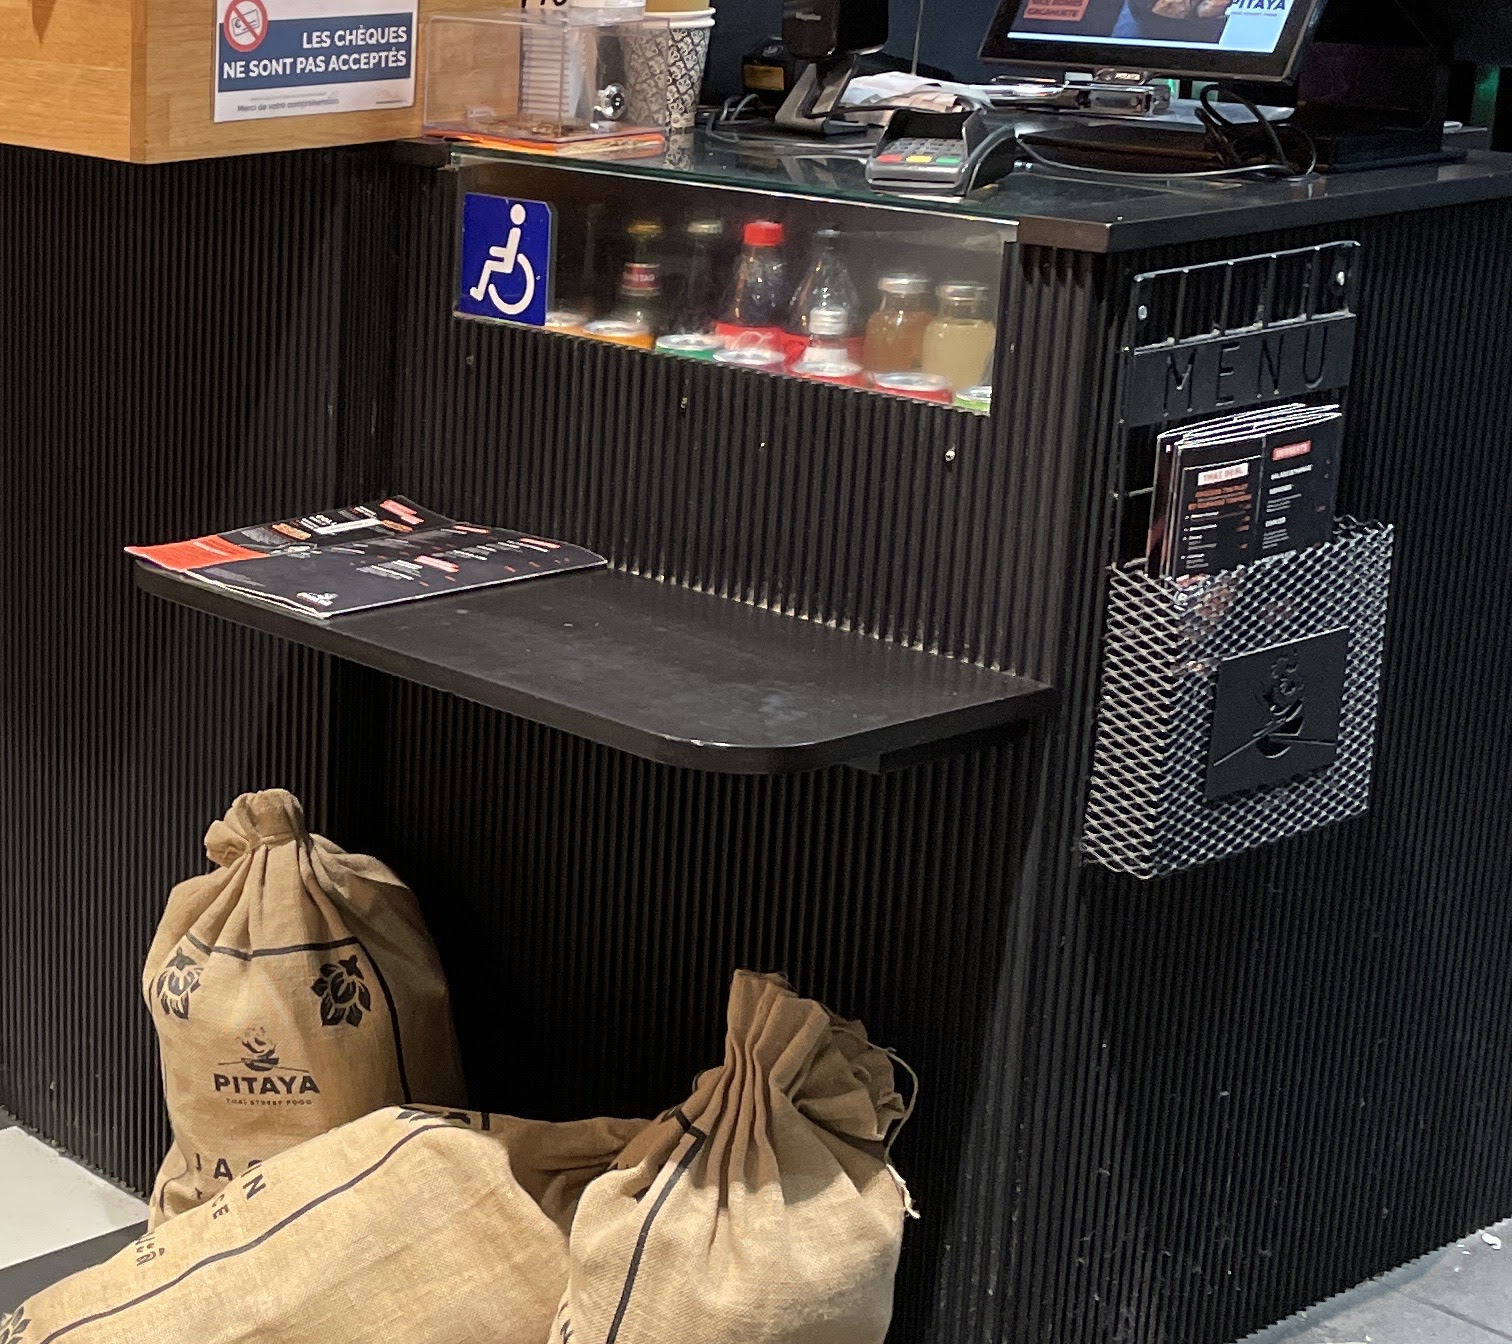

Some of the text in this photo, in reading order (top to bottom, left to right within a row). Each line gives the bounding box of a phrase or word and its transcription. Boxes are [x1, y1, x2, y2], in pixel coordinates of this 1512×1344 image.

[302, 24, 408, 49] LES CHÈQUES
[223, 46, 407, 79] NE SONT PAS ACCEPTÉS
[237, 103, 258, 112] Merci
[259, 103, 268, 112] de
[268, 102, 286, 111] votre
[1163, 326, 1329, 418] MENU
[213, 1073, 320, 1095] PITAYA
